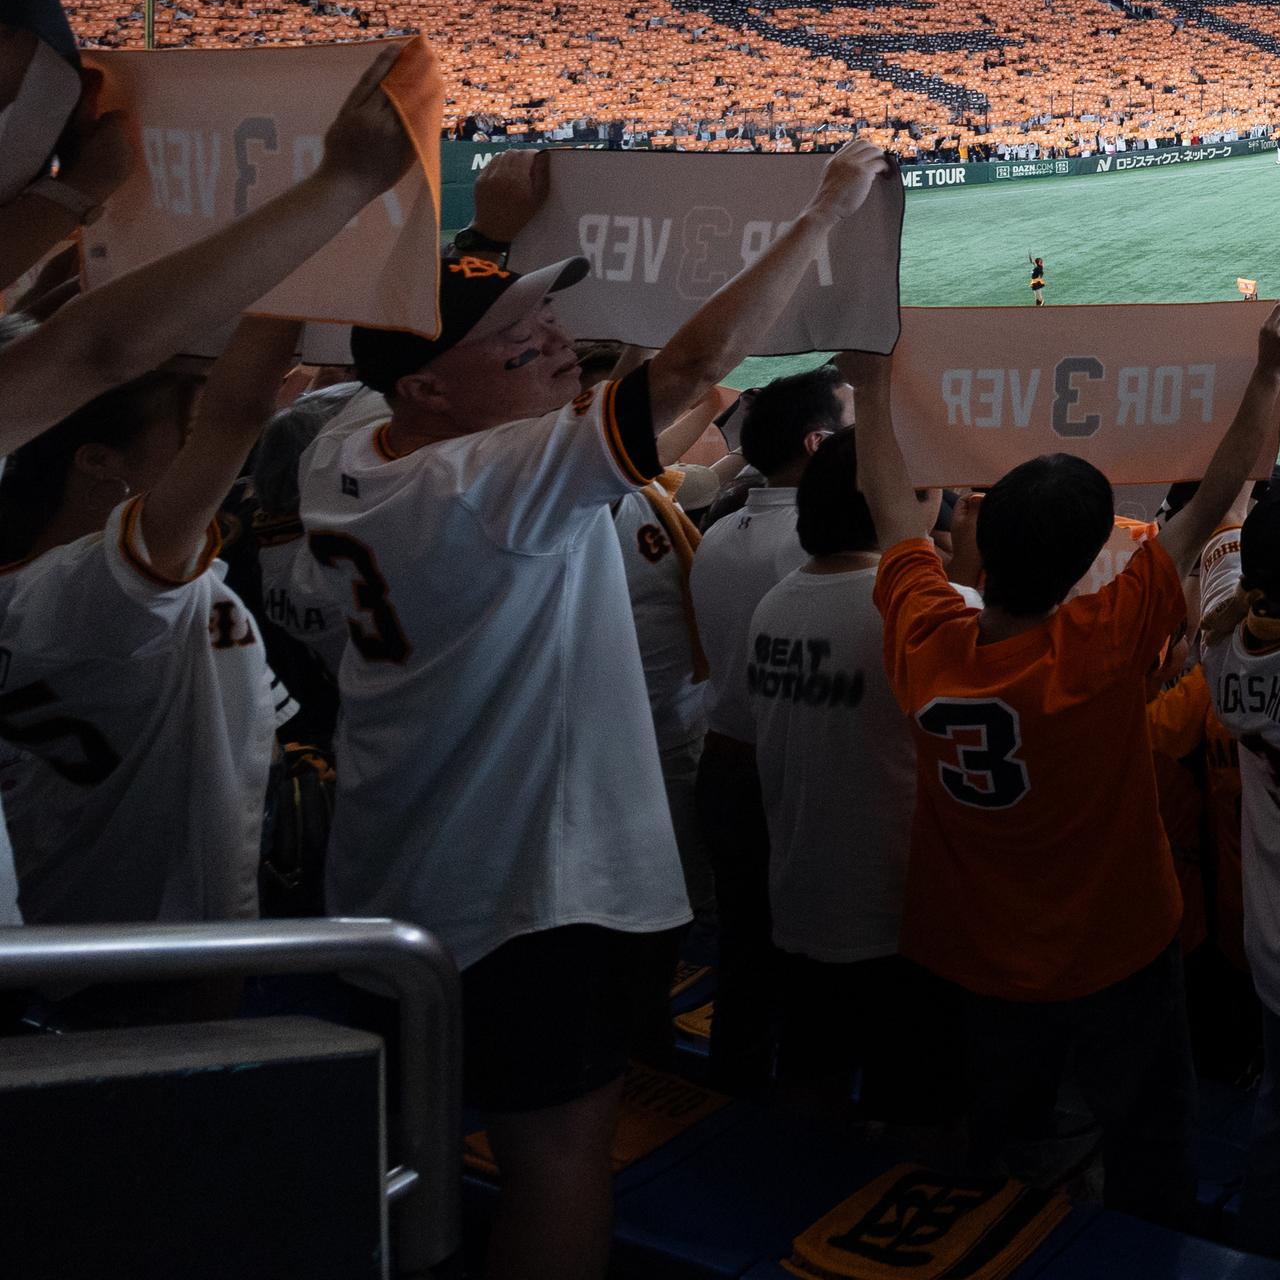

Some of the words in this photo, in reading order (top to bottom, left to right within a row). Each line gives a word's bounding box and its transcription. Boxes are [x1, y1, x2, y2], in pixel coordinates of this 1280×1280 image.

[1012, 163, 1054, 174] DAZN.COM
[1116, 146, 1232, 170] ロジスティクス・ネットワーク
[927, 167, 966, 185] TOUR
[754, 632, 832, 674] BEAT
[914, 695, 1033, 811] 3
